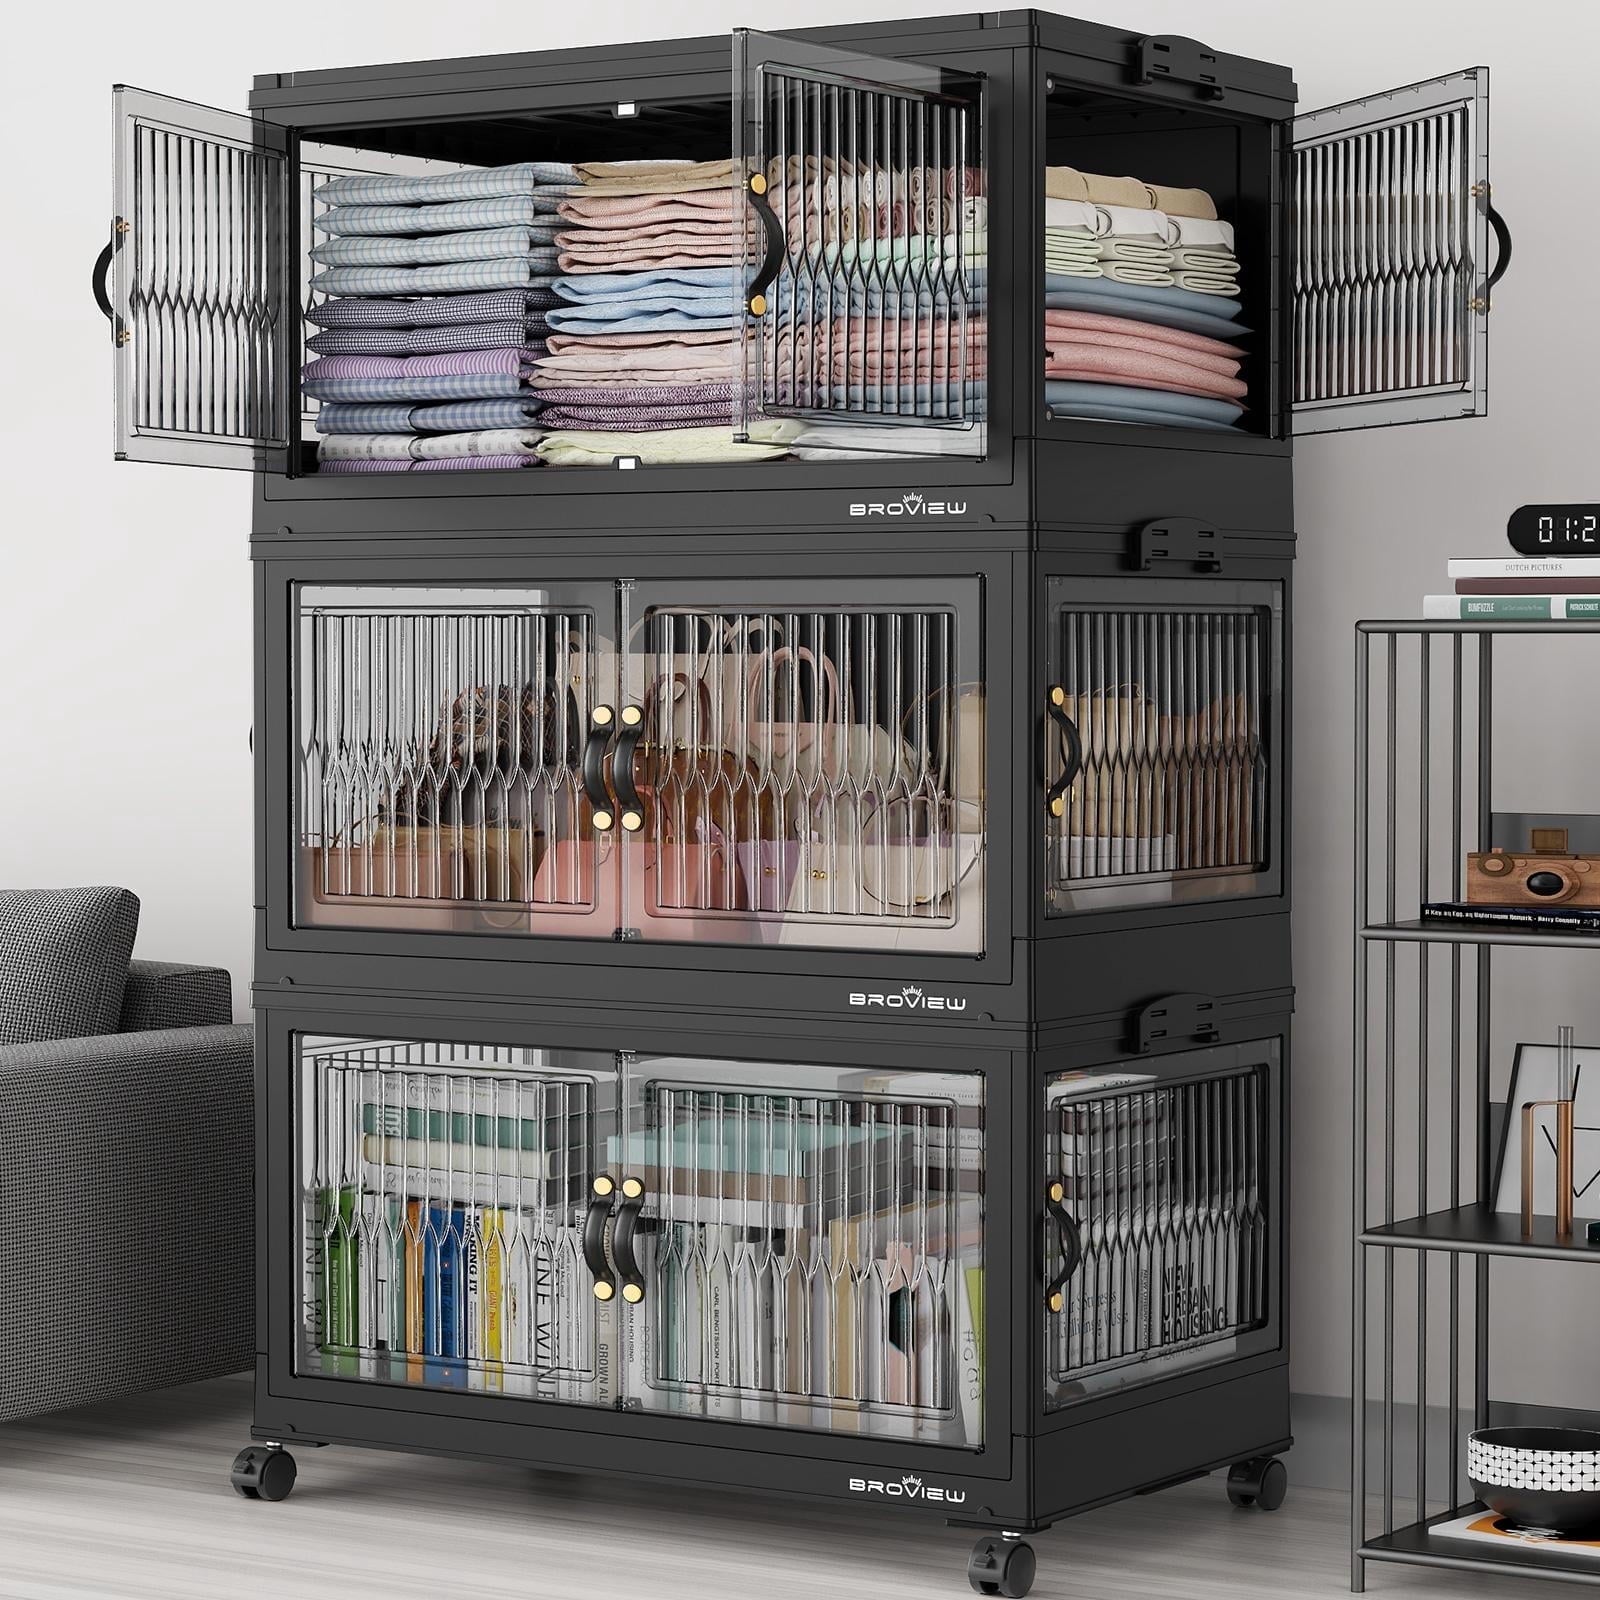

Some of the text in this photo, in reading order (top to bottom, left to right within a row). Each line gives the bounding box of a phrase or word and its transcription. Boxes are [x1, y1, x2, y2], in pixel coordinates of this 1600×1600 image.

[849, 499, 967, 516] BROVIEW
[1538, 516, 1596, 543] 01:2
[1505, 563, 1563, 572] DUTCH PICTURES
[849, 990, 966, 1010] BROVIEW
[469, 1278, 478, 1295] IT
[599, 1343, 609, 1404] GROWN AL
[849, 1477, 966, 1503] BROVIEW
